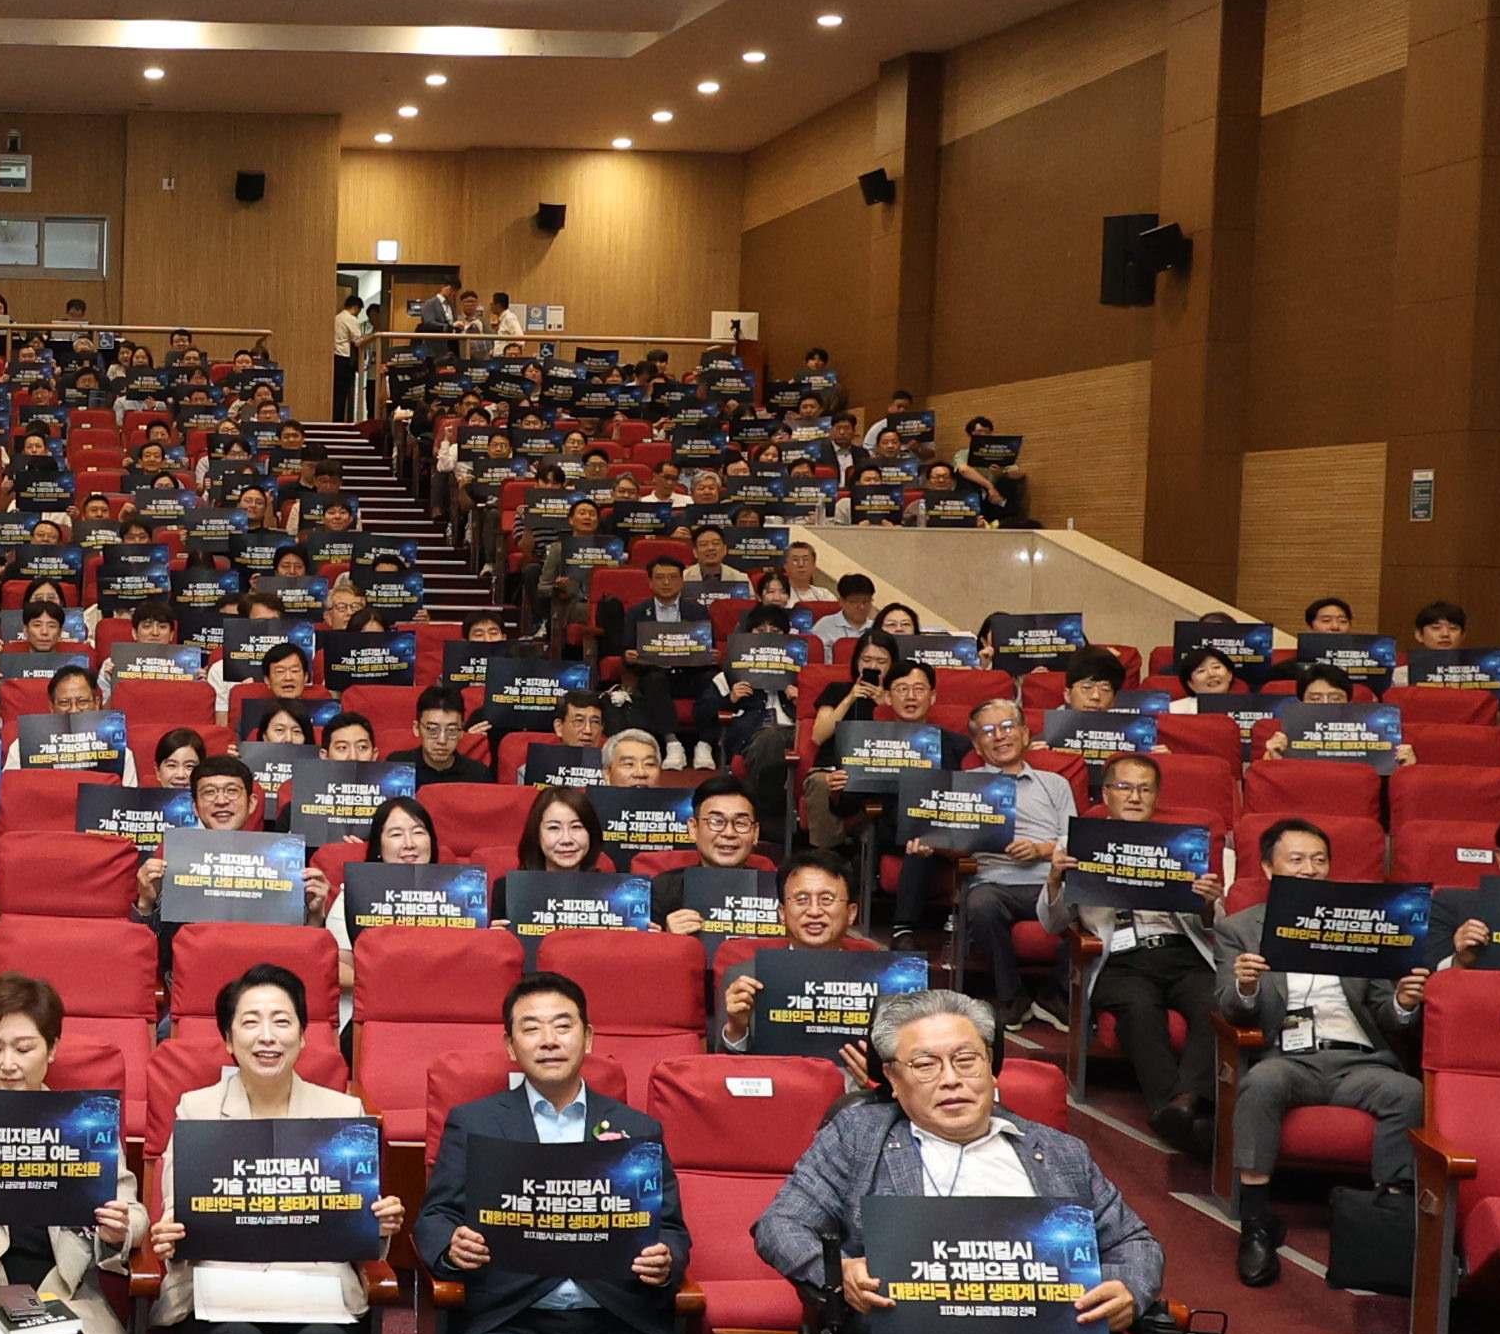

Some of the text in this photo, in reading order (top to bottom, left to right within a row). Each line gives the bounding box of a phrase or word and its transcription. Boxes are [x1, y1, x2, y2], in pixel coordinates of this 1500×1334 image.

[233, 1159, 319, 1175] K-피지컬AI
[213, 1177, 341, 1195] 기술 자립으로 여는
[191, 1197, 245, 1212] 대한민국
[248, 1196, 275, 1211] 산업
[279, 1195, 319, 1211] 생태계
[933, 1241, 1032, 1259] K-피지컬AI
[911, 1262, 1058, 1281] 기술 자립으로 여는
[888, 1283, 951, 1301] 대한민국
[954, 1283, 985, 1301] 산업
[988, 1283, 1035, 1301] 생태계
